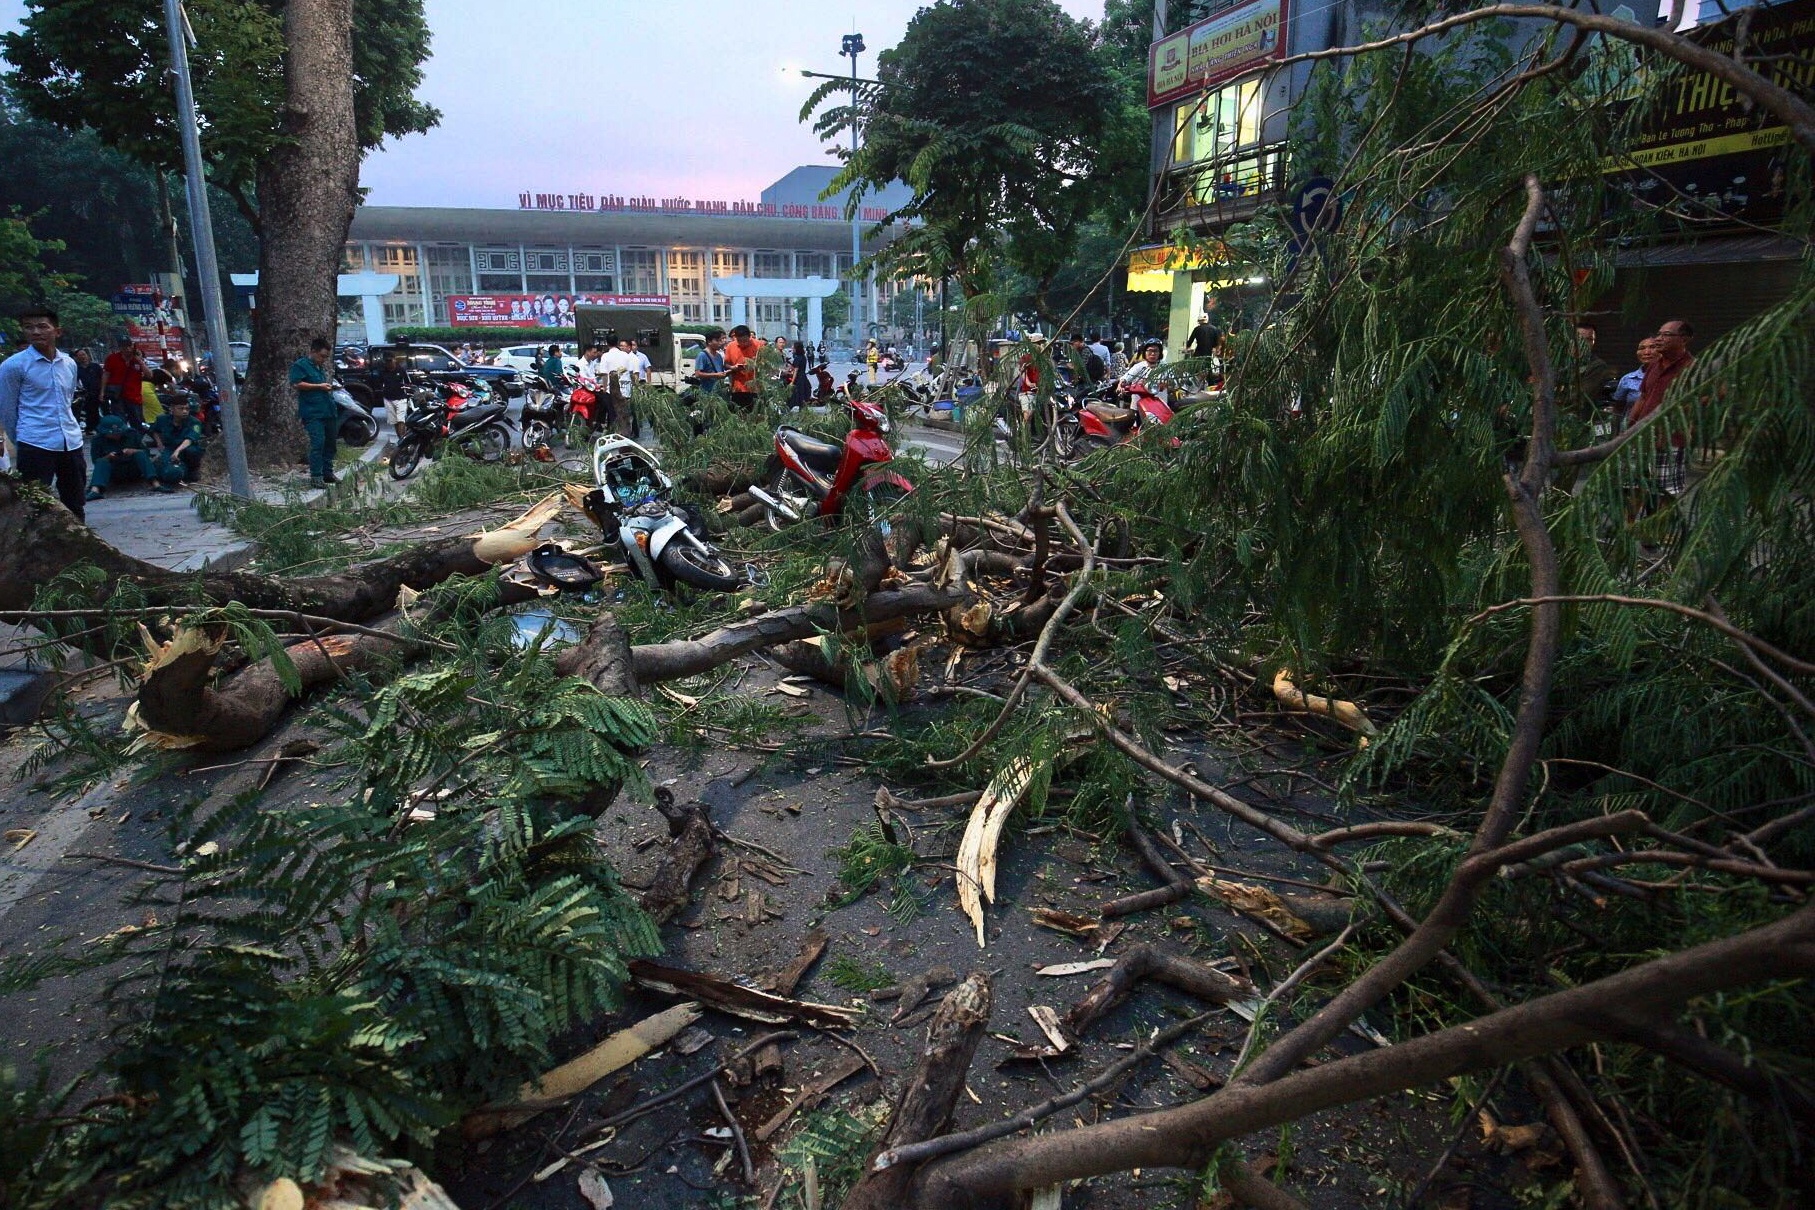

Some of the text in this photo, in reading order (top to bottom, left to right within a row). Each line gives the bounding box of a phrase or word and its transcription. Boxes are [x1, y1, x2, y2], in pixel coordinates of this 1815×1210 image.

[1191, 44, 1209, 58] BIA
[519, 190, 532, 209] VÌ
[536, 193, 564, 211] MỤC
[568, 192, 595, 210] TIÊU
[600, 194, 625, 212] DÂN
[782, 202, 808, 219] CÔNG
